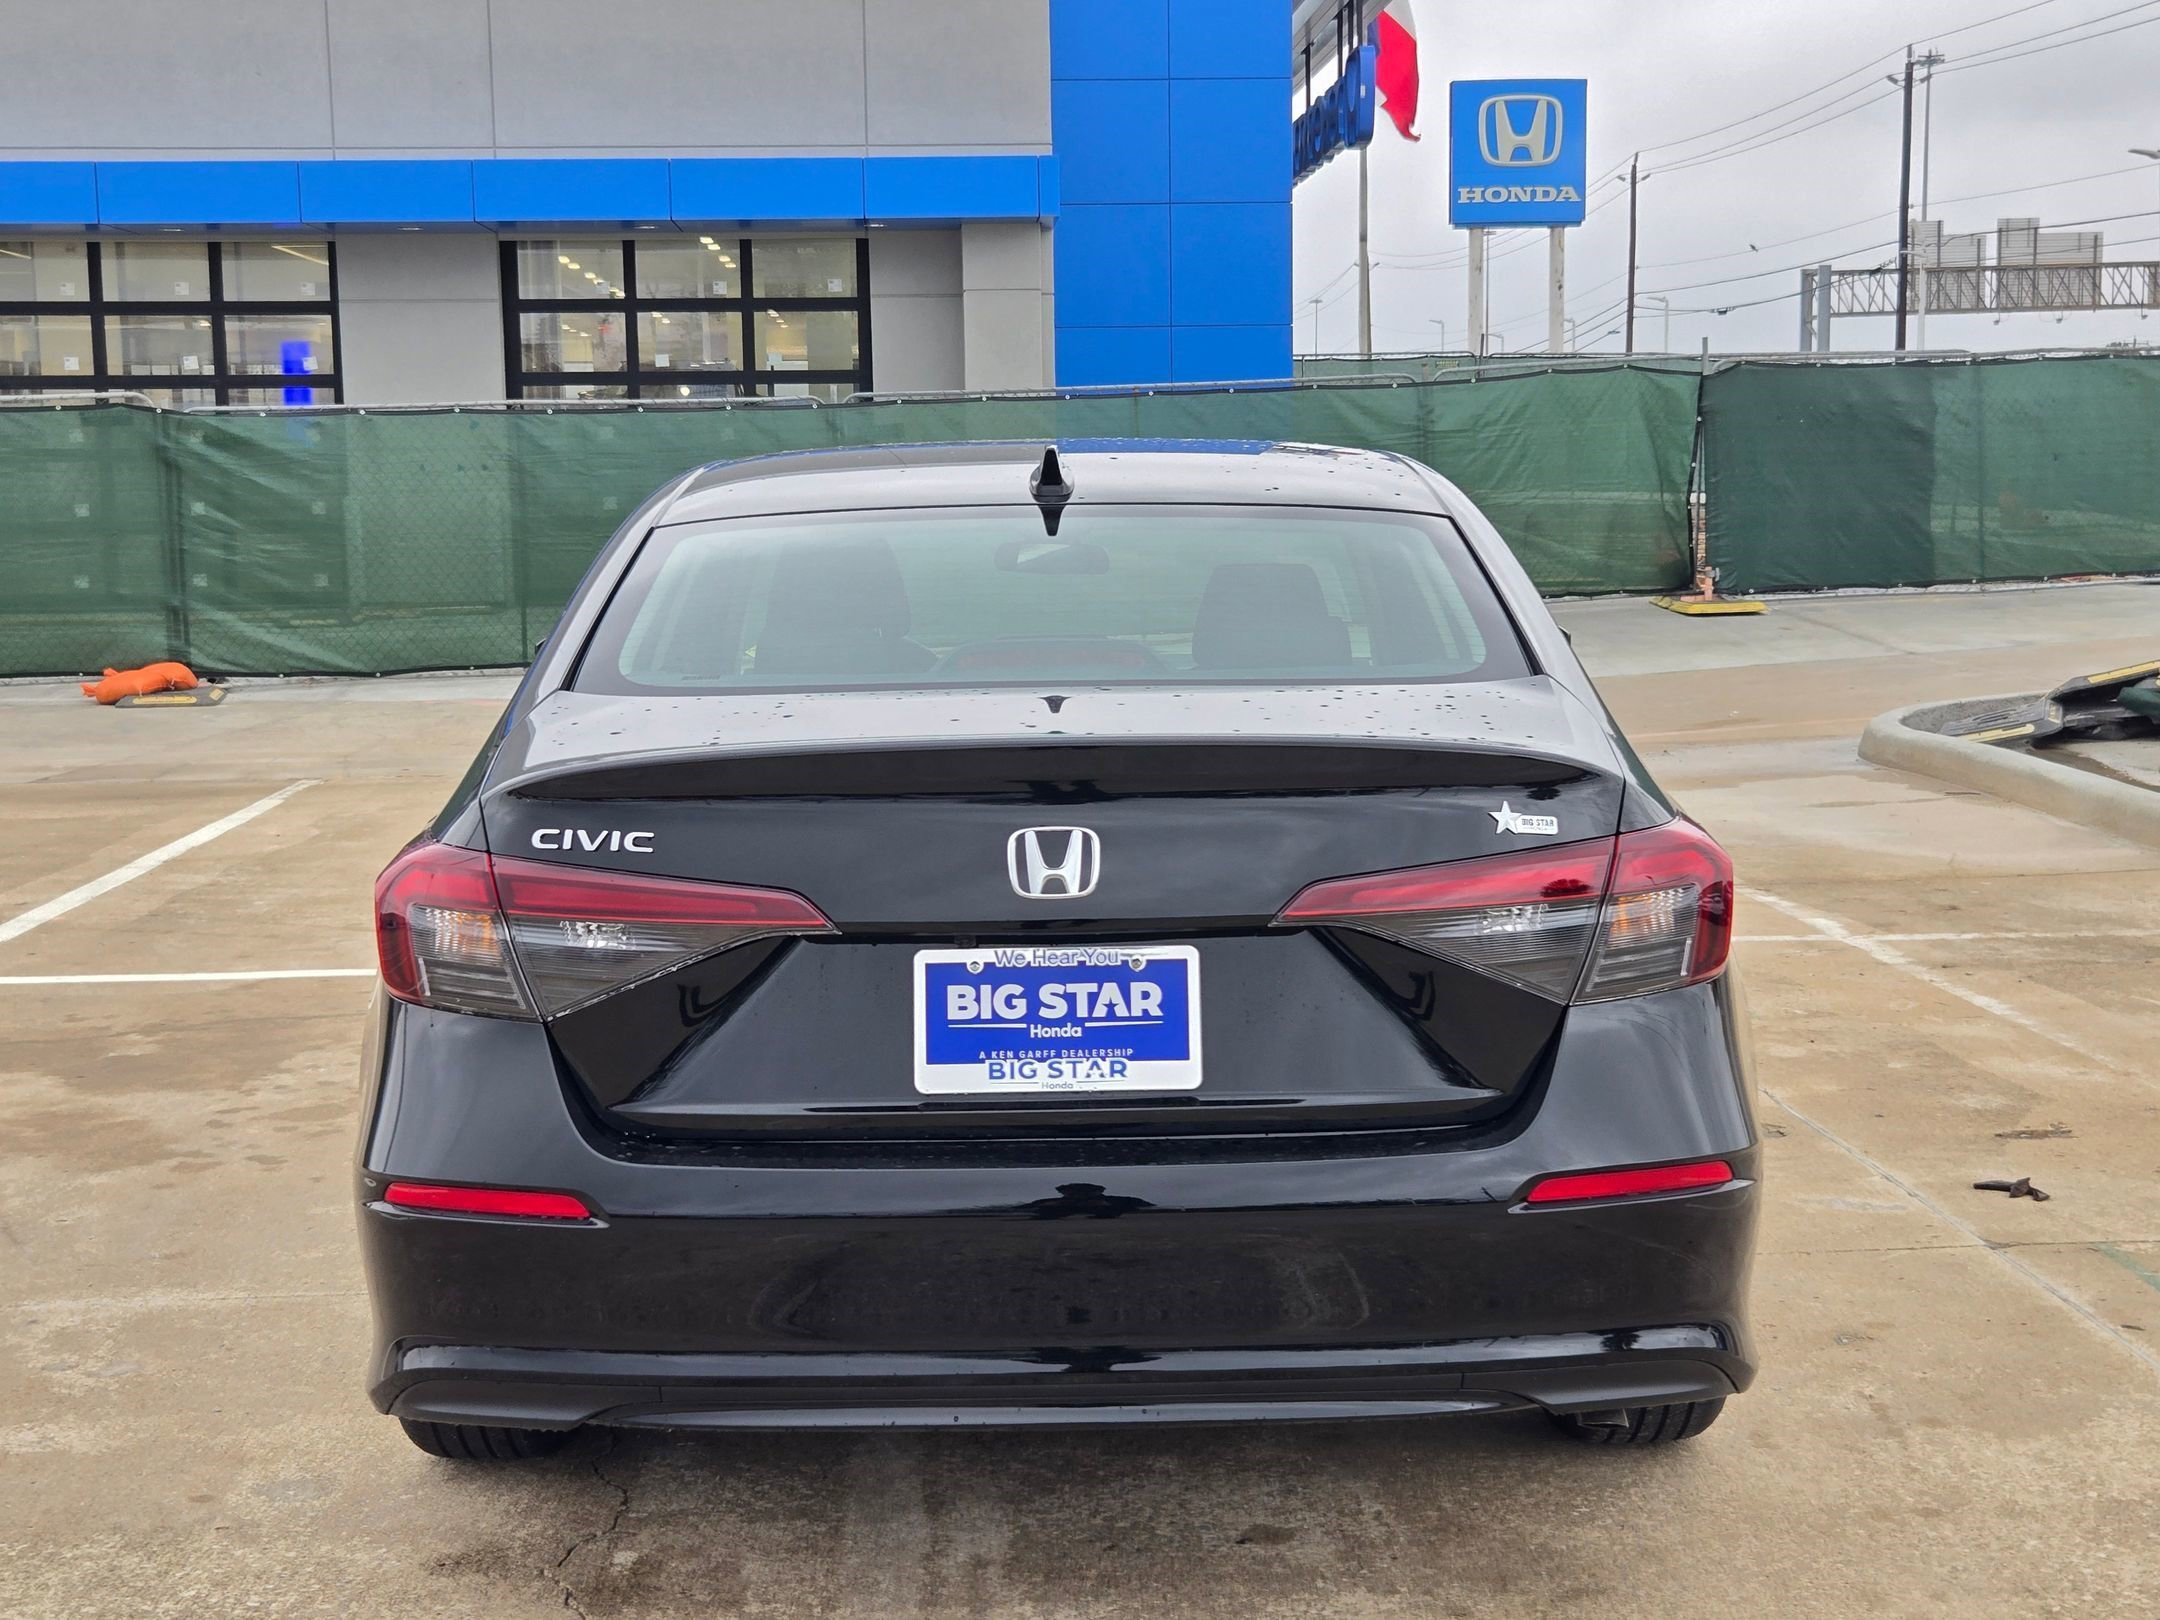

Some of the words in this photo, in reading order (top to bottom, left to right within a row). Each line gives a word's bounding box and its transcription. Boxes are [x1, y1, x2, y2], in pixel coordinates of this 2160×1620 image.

[1457, 186, 1581, 204] HONDA
[1536, 819, 1554, 827] STAR
[531, 828, 655, 853] CIVIC
[994, 950, 1025, 966] We
[1032, 949, 1079, 965] Hear
[1086, 948, 1119, 964] You
[946, 984, 1027, 1020] BIG
[1038, 981, 1164, 1019] STAR
[1030, 1023, 1082, 1038] Honda
[979, 1051, 986, 1059] A
[992, 1050, 1013, 1059] KEN
[1019, 1050, 1056, 1058] GARFF
[1062, 1048, 1133, 1057] DEALERSHIP
[988, 1062, 1037, 1080] BIG
[1047, 1060, 1127, 1079] STAR
[1041, 1081, 1074, 1090] Honda
